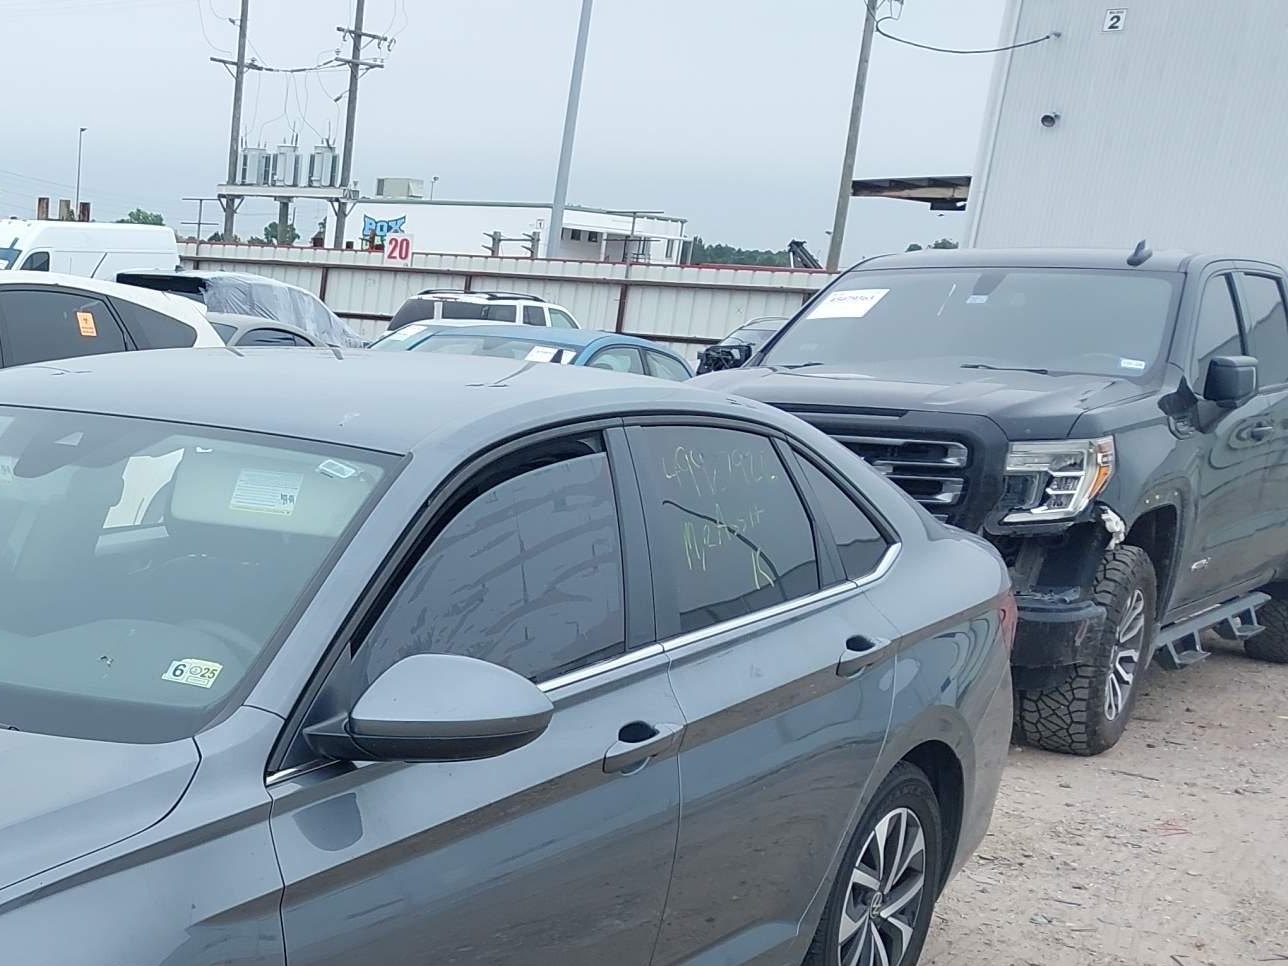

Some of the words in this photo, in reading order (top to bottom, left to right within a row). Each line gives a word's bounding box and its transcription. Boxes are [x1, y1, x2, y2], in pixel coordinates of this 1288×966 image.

[1107, 14, 1121, 30] 2
[387, 237, 410, 260] 20
[172, 663, 187, 678] 6
[199, 667, 218, 679] 25
